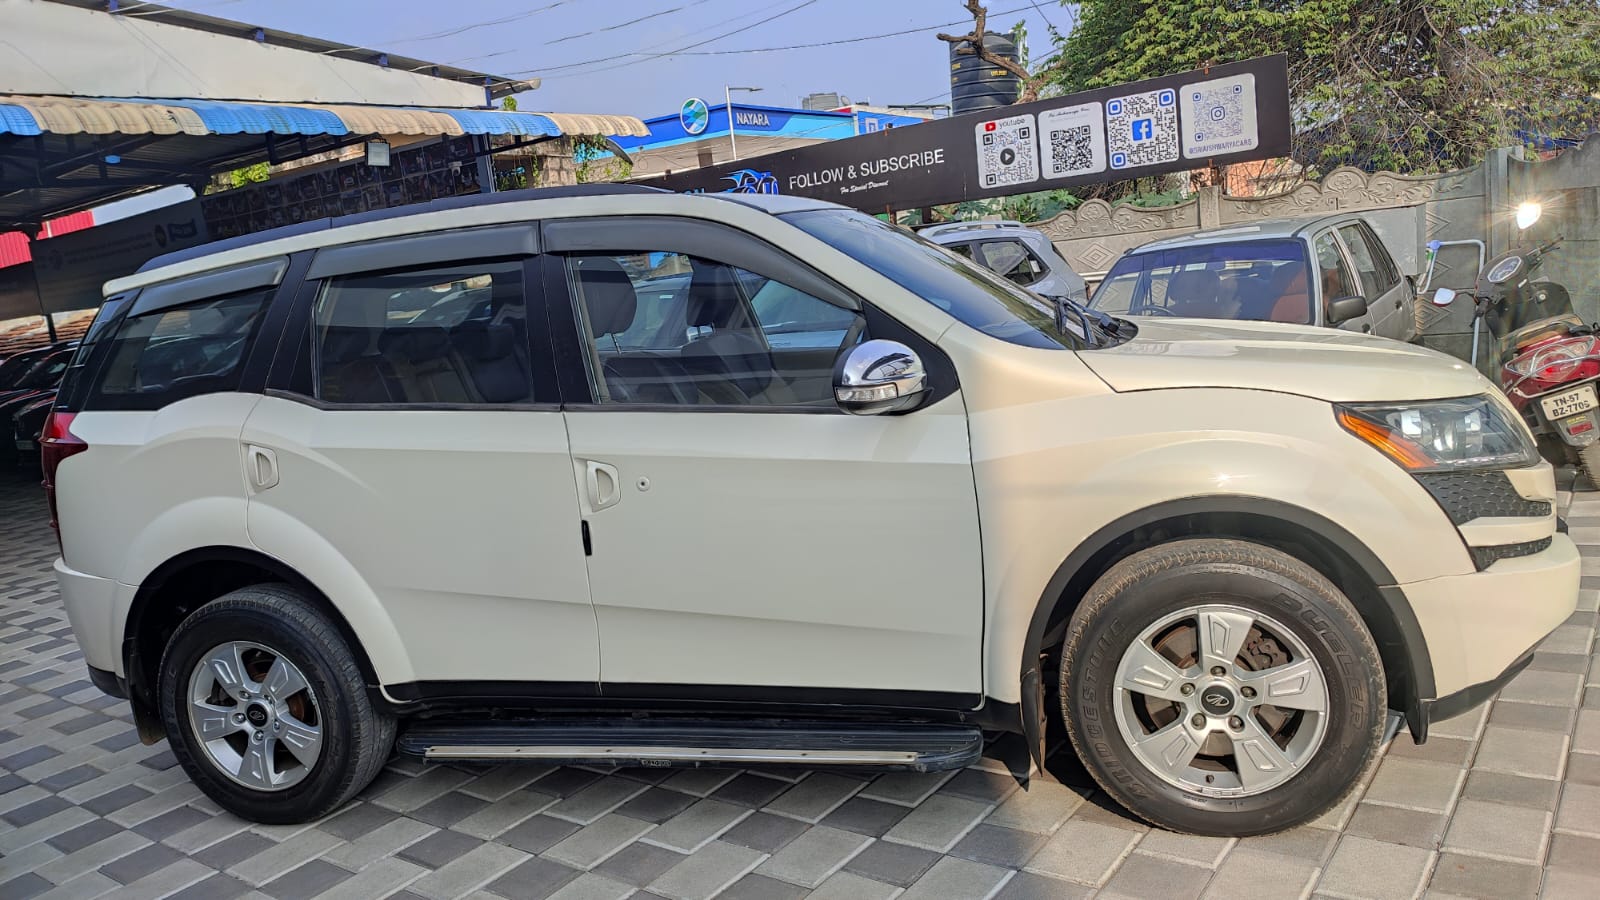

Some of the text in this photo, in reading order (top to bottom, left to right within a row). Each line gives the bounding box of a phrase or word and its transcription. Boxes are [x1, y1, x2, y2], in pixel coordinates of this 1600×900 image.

[736, 112, 770, 127] NAYARA
[789, 148, 945, 190] FOLLOW & SUBSCRIBE
[1552, 393, 1580, 407] TN-57
